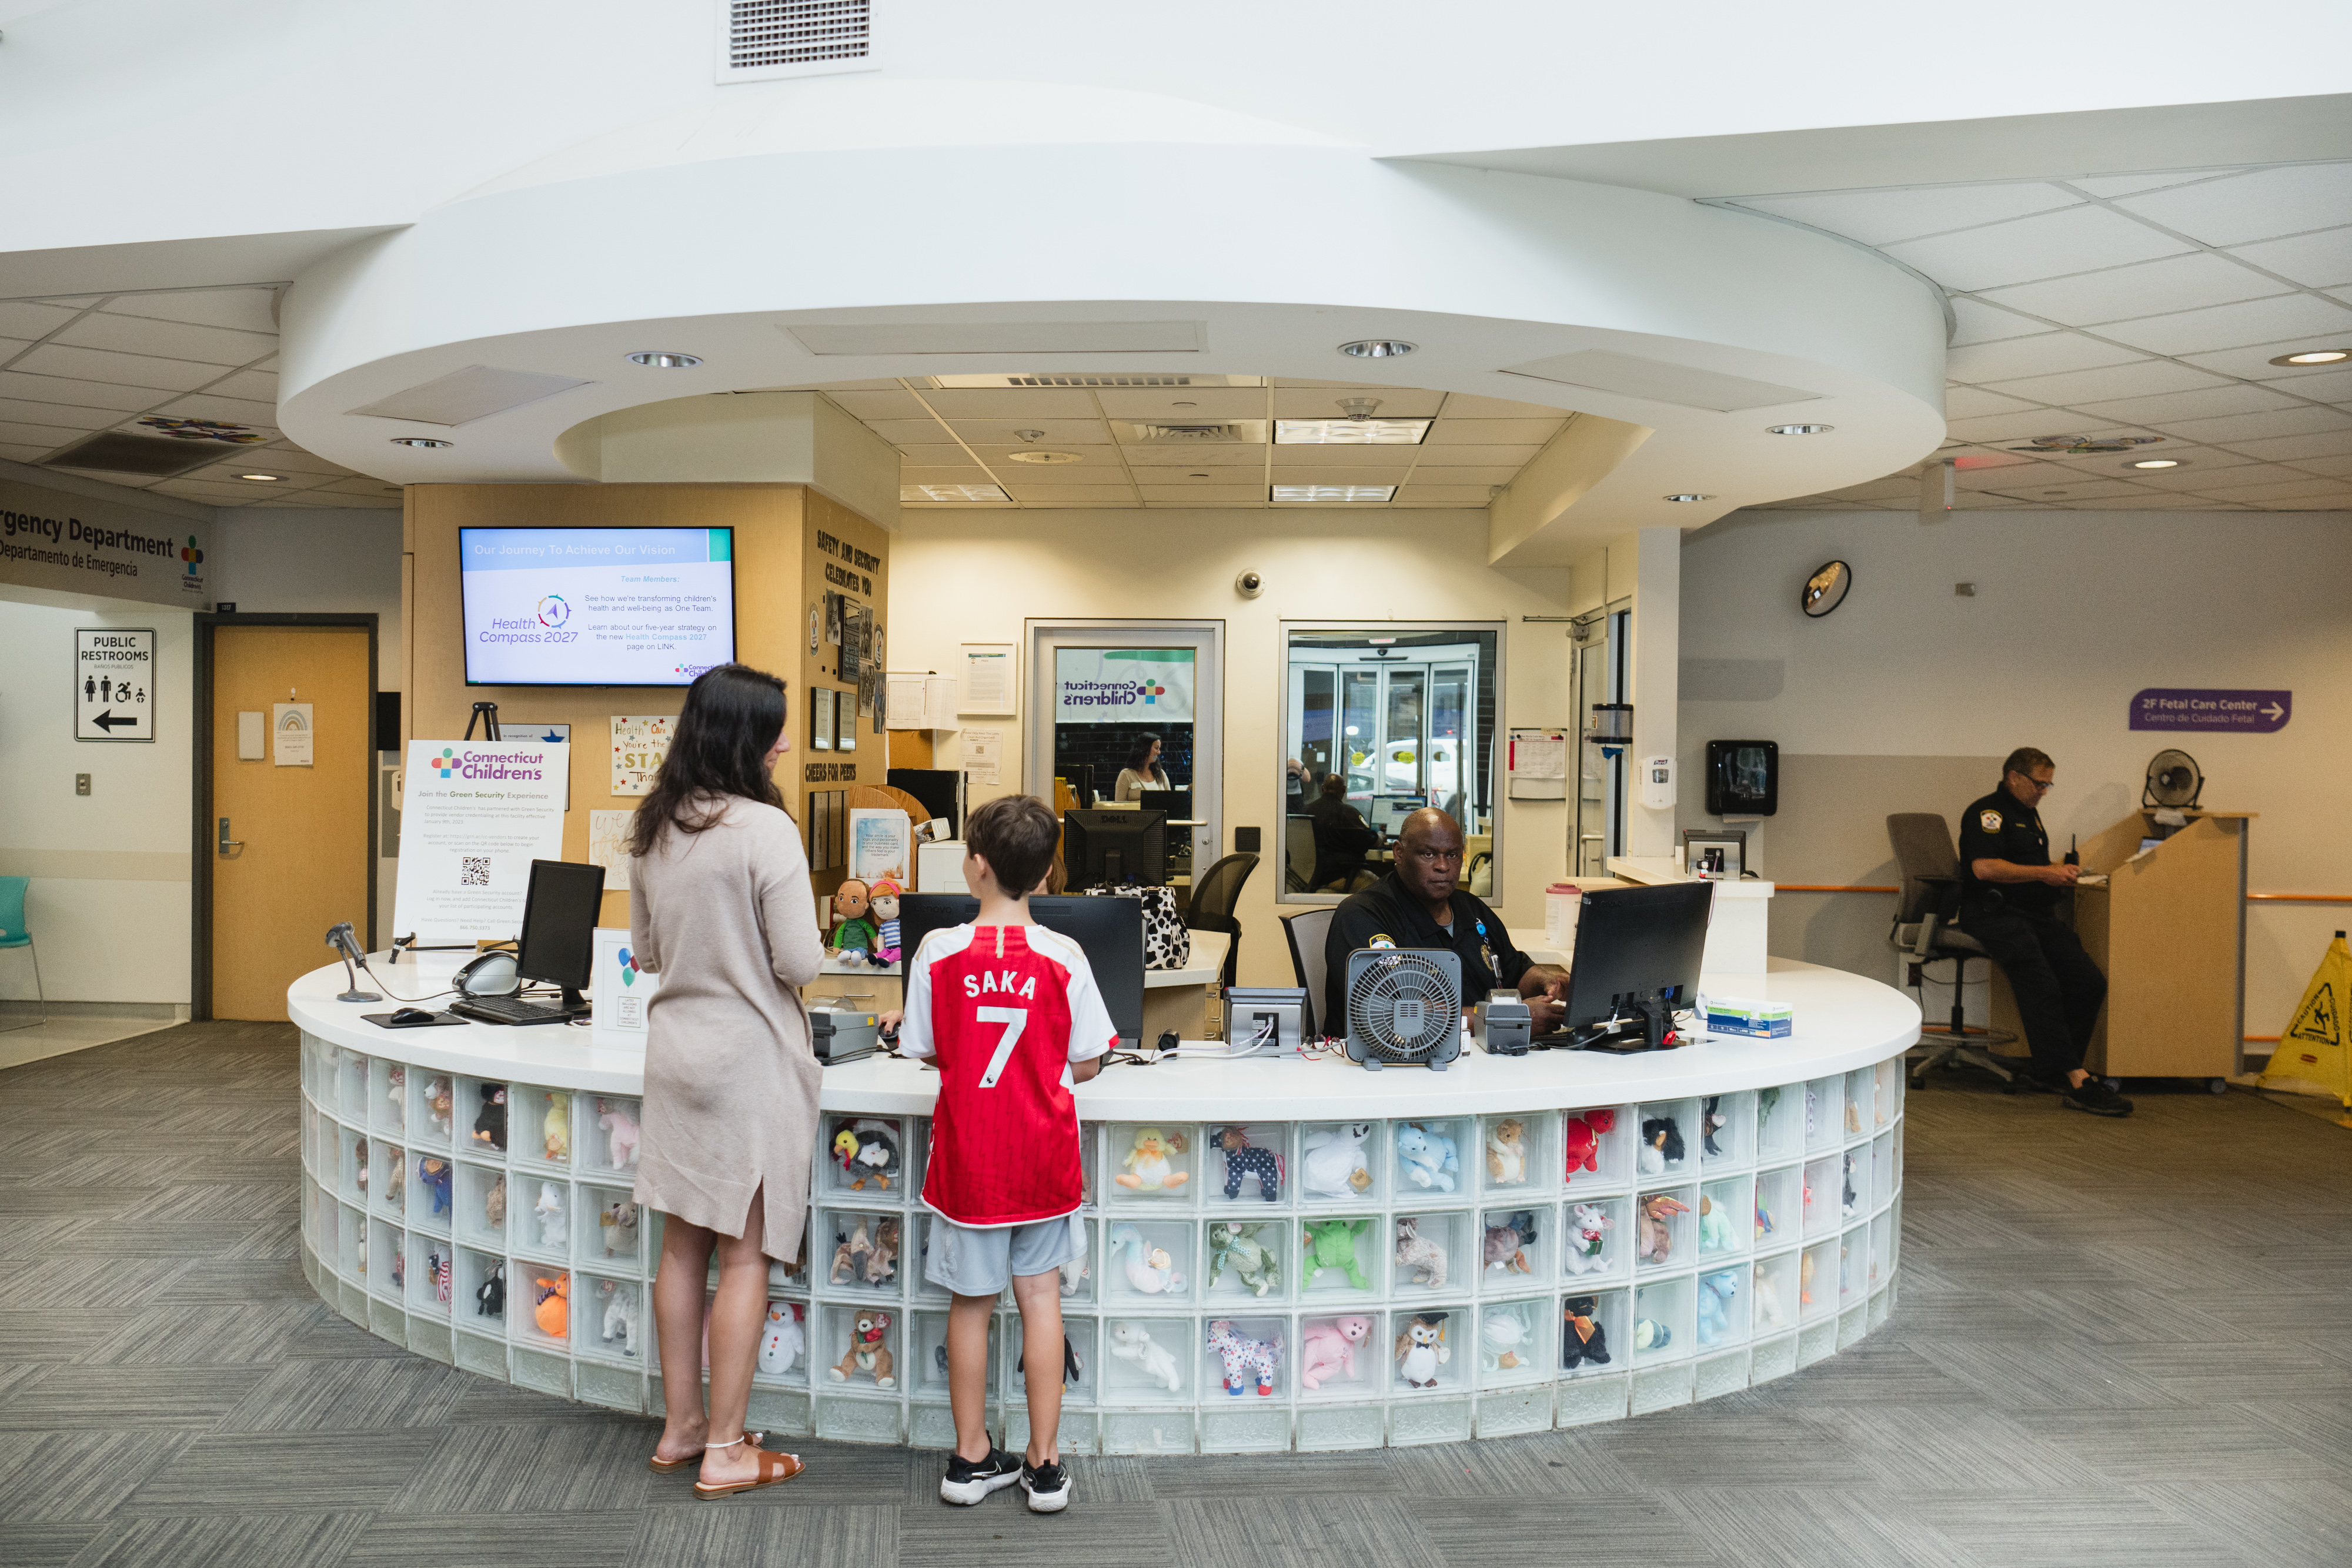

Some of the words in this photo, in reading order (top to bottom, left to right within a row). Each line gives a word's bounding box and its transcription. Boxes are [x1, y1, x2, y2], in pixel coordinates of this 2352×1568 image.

[69, 518, 173, 558] Department
[474, 545, 495, 554] Our
[499, 545, 545, 557] Journey
[548, 545, 563, 554] To
[565, 545, 610, 554] Achieve
[615, 545, 636, 554] Our
[639, 545, 675, 555] Vision
[818, 529, 840, 557] SAFETY
[841, 542, 853, 563] AND
[854, 548, 881, 575] SECURITY
[72, 551, 83, 568] de
[87, 554, 137, 577] Emergencia
[182, 574, 203, 582] Connecticut
[184, 582, 201, 590] Children's
[862, 575, 871, 597] YOU
[637, 595, 680, 603] transforming
[627, 605, 661, 613] well-being
[492, 617, 535, 629] Health
[645, 623, 675, 632] five-year
[94, 637, 136, 647] PUBLIC
[479, 631, 541, 645] Compass
[543, 631, 578, 643] 2027
[82, 651, 148, 661] RESTROOMS
[2143, 699, 2157, 709] 2F
[2160, 699, 2188, 710] Fetal
[2191, 700, 2217, 710] Care
[2219, 700, 2257, 710] Center
[2146, 713, 2175, 722] Centro
[2178, 713, 2190, 722] de
[2192, 713, 2229, 723] Cuidado
[2232, 714, 2254, 724] Fetal
[616, 723, 644, 735] Health
[651, 724, 666, 734] Care
[651, 739, 666, 748] the
[463, 751, 543, 764] Connecticut
[625, 752, 663, 768] STA
[462, 764, 542, 780] Children's
[629, 771, 654, 782] Tha
[805, 763, 827, 782] CHEERS
[828, 763, 838, 781] FOR
[840, 763, 856, 781] PEERS
[475, 791, 505, 800] Security
[914, 904, 951, 913] Lenovo
[1376, 936, 1396, 945] SECURITY
[963, 970, 1036, 1000] SAKA
[2297, 993, 2319, 1024] CAUTION
[2297, 1033, 2330, 1045] ATTENTION
[976, 1006, 1028, 1088] 7
